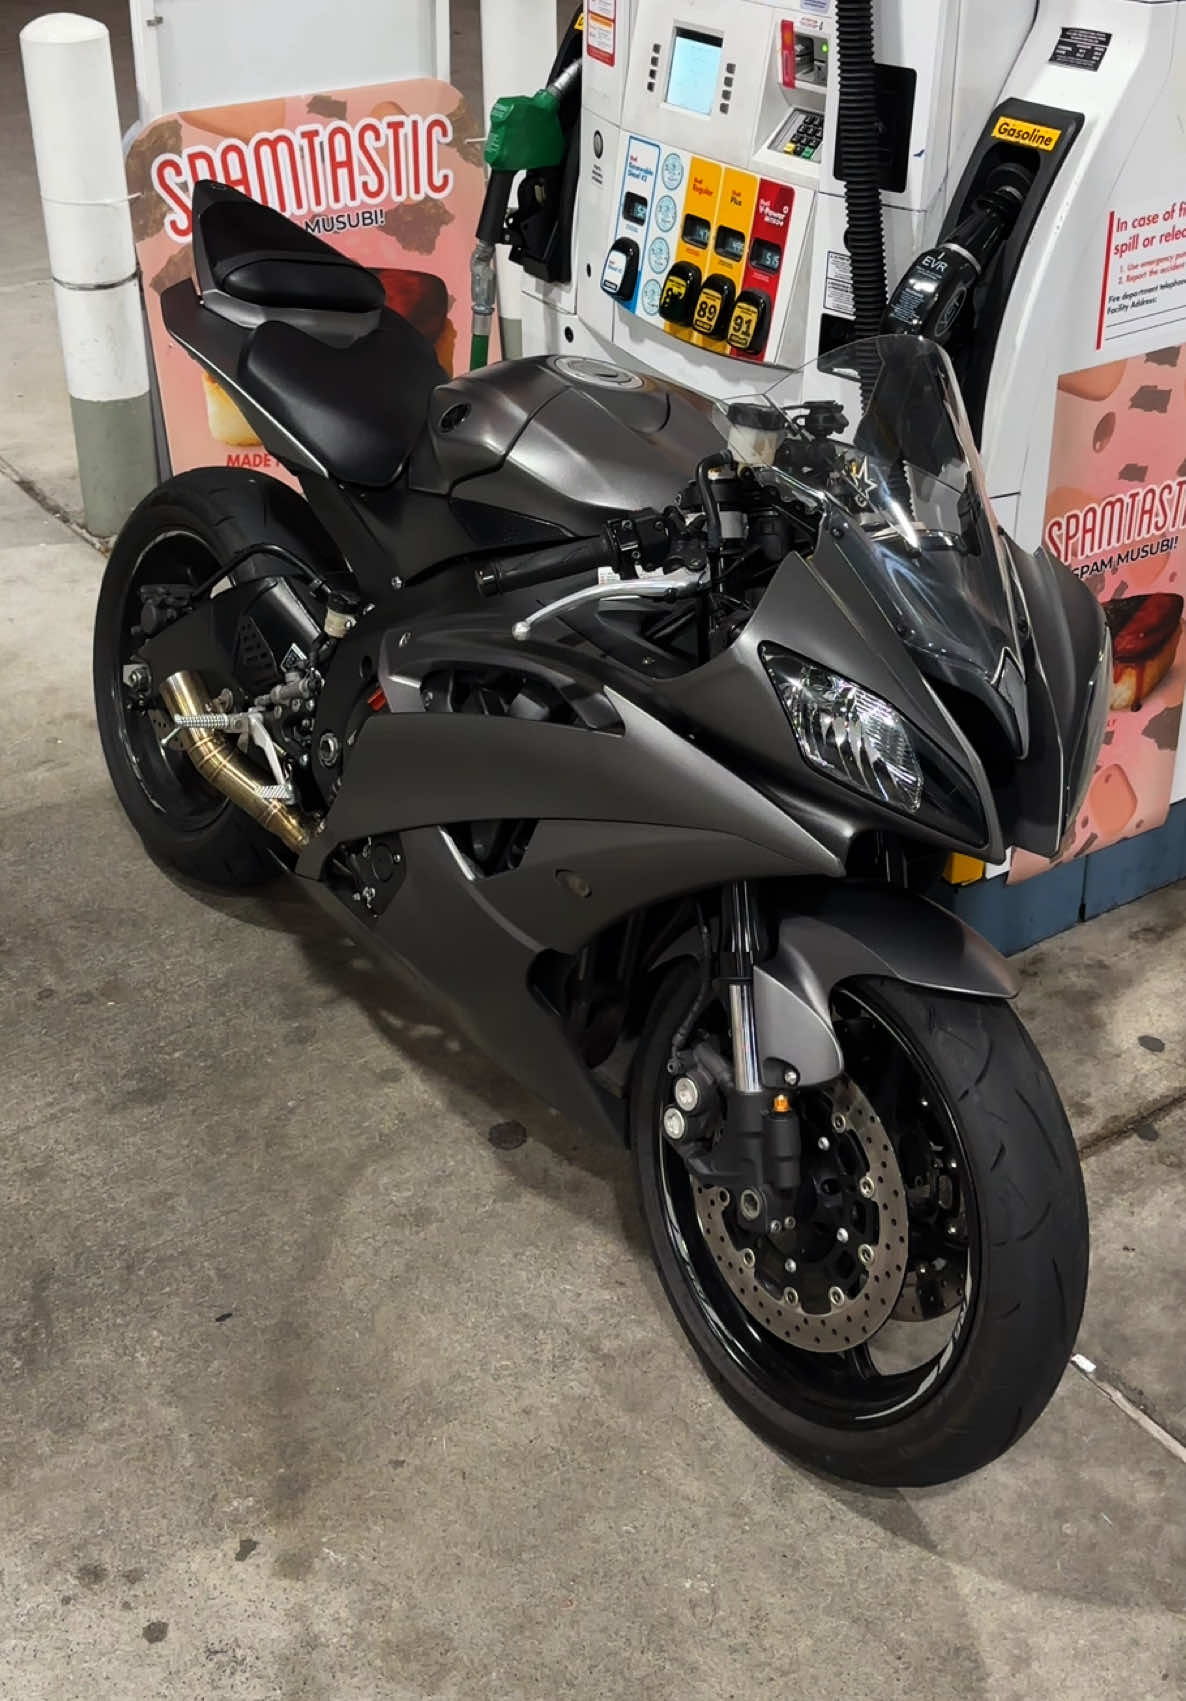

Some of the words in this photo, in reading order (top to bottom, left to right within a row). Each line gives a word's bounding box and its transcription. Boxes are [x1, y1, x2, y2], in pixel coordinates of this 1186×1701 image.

[998, 122, 1053, 146] Gasoline
[305, 209, 385, 233] MUSUBI!
[1116, 217, 1128, 232] In
[1131, 213, 1159, 229] case
[1163, 202, 1176, 221] of
[1113, 233, 1139, 258] spill
[1143, 235, 1156, 249] or
[921, 256, 948, 272] EVR
[697, 300, 717, 323] 89
[732, 314, 753, 338] 91
[227, 452, 272, 468] MADE
[1118, 536, 1179, 566] MUSUBI!
